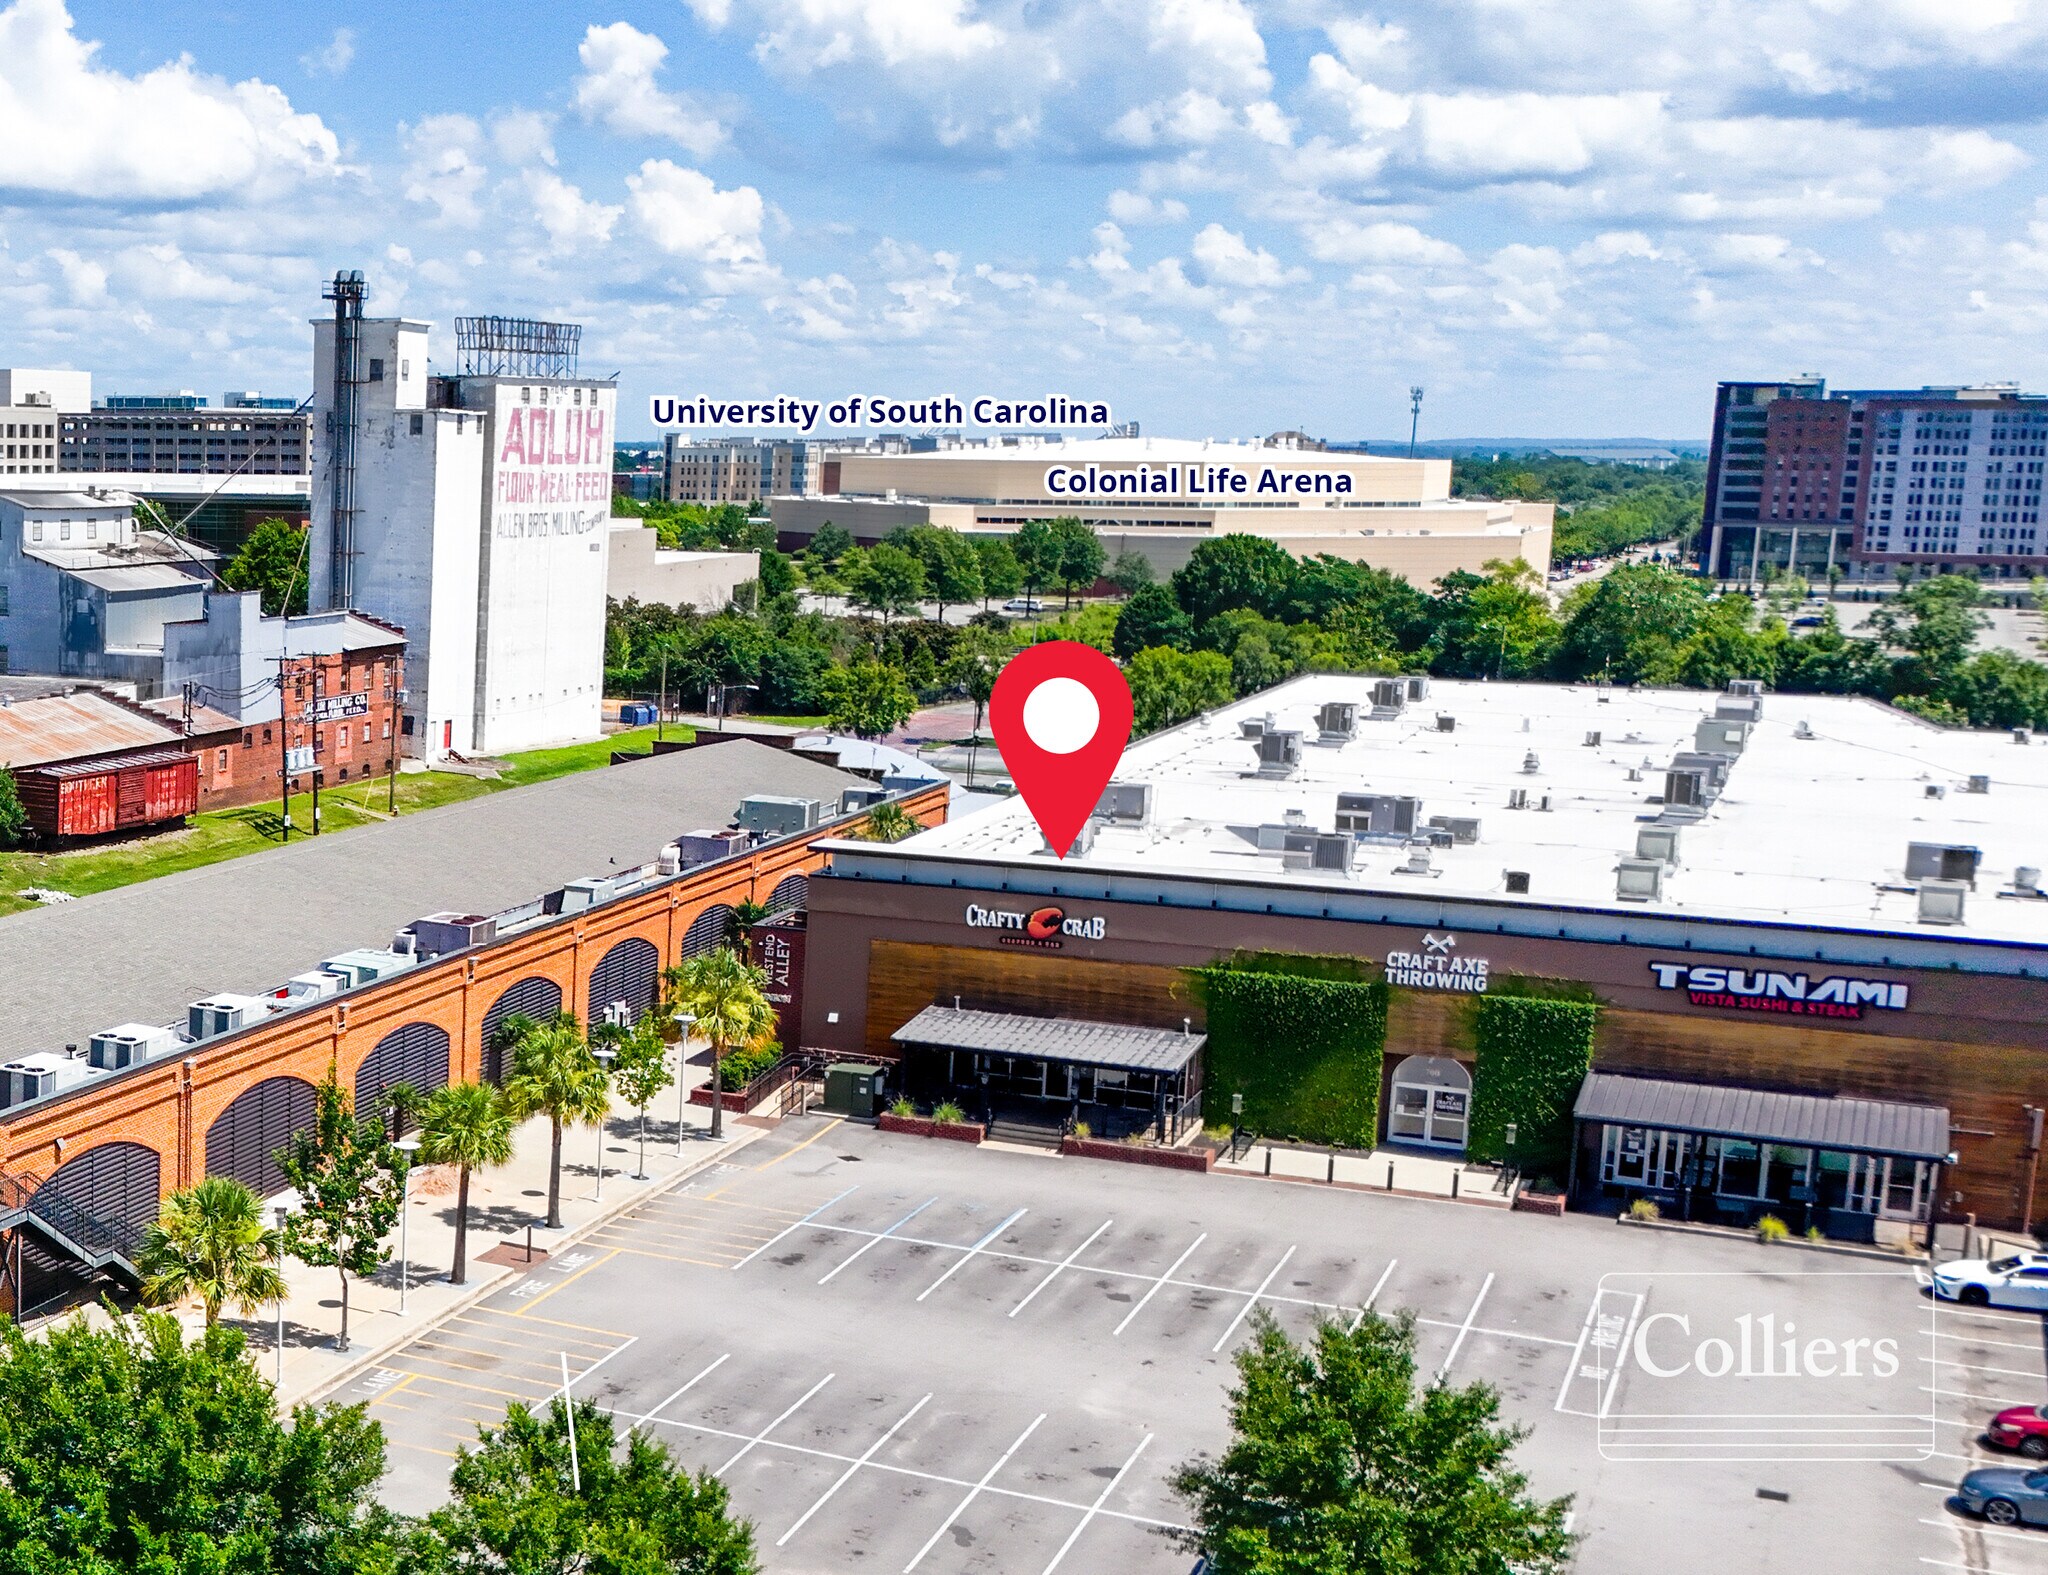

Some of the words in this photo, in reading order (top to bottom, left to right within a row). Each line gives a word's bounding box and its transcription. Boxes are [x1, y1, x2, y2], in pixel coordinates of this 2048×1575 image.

[500, 407, 604, 465] ADLUH
[496, 512, 525, 539] ALLEN
[552, 510, 585, 537] MILLING
[327, 696, 353, 710] MILLING
[965, 903, 1026, 930] CRAFTY
[1062, 916, 1106, 940] CRAB
[765, 934, 776, 957] END
[775, 938, 791, 987] ALLEY
[1386, 951, 1448, 972] CRAFT
[1448, 957, 1489, 976] AXE
[1384, 967, 1488, 992] THROWING
[1650, 963, 1909, 1010] TSUNAMI
[1689, 992, 1736, 1007] VISTA
[1739, 995, 1788, 1012] SUSHI
[1791, 1002, 1802, 1013] &
[1807, 1003, 1860, 1019] STEAK
[548, 1252, 595, 1273] LANE
[350, 1369, 405, 1396] LANE
